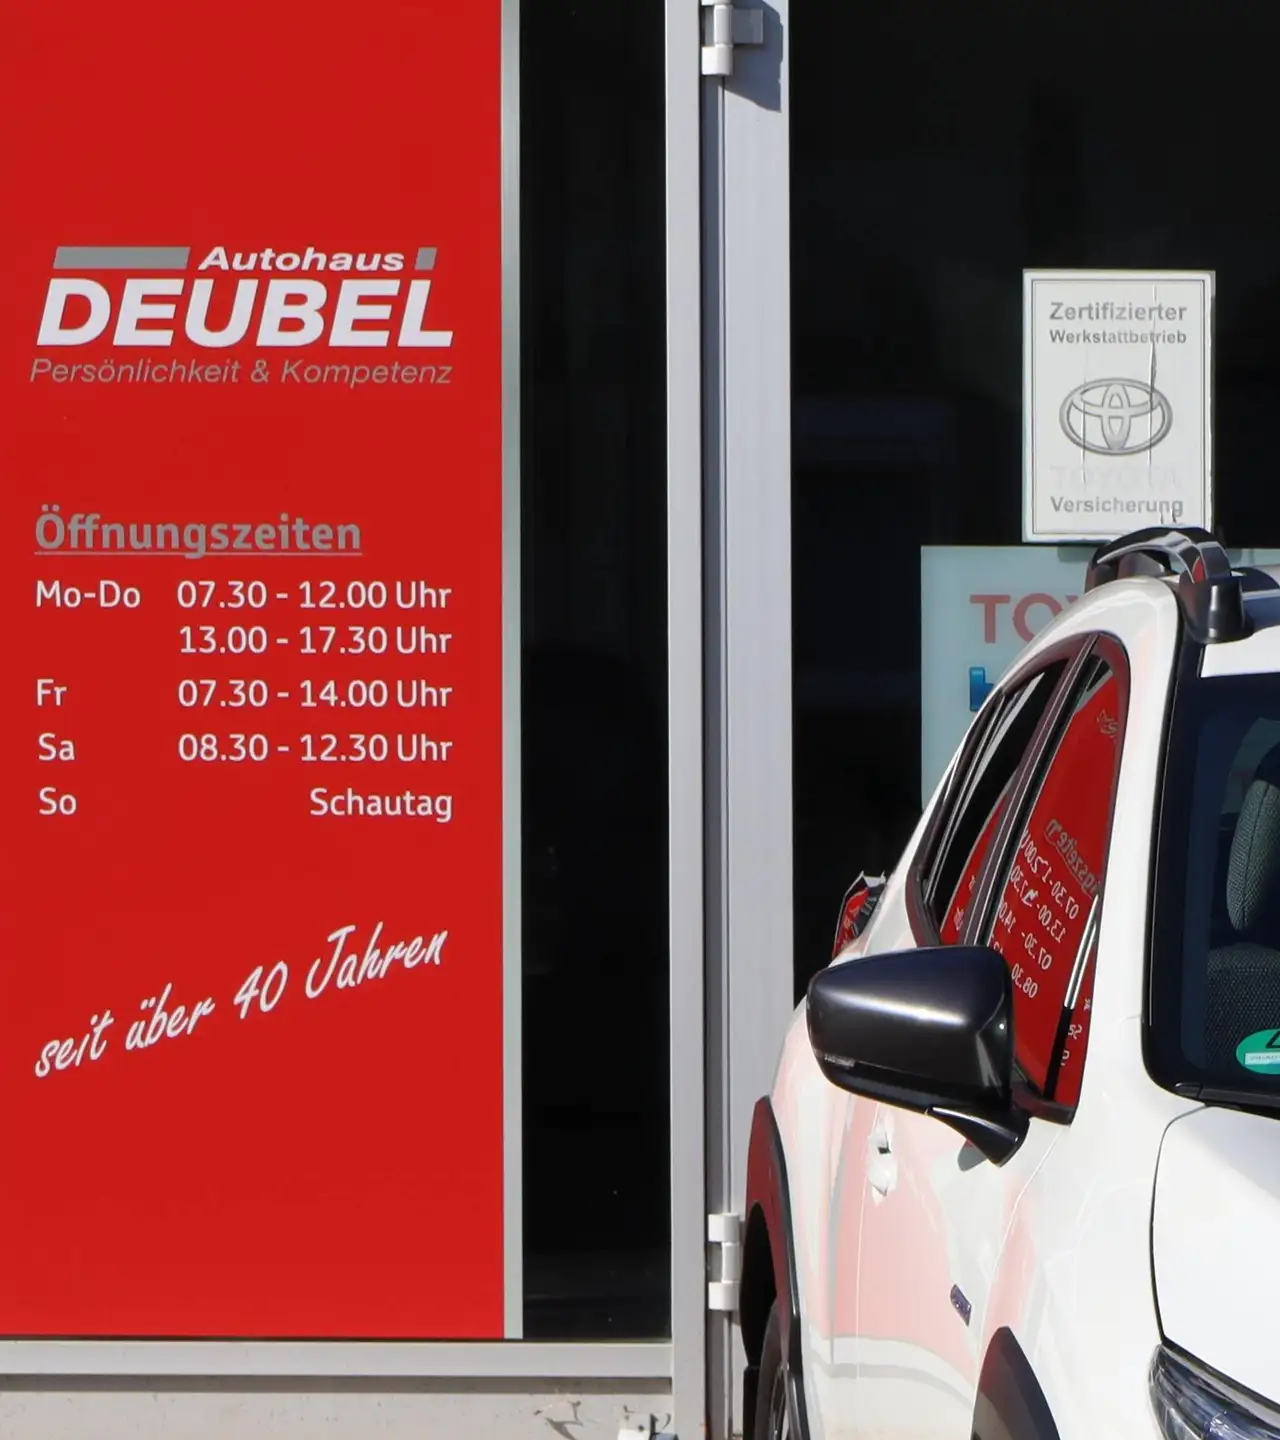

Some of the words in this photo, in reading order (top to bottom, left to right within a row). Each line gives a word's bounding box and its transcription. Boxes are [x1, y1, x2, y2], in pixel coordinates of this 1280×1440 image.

[198, 245, 405, 272] Autohaus
[37, 278, 454, 348] DEUBEL
[1049, 302, 1188, 322] Zertifizierter
[1049, 330, 1187, 344] Werkstattbetrieb
[30, 358, 241, 383] Persönlichkeit
[250, 359, 270, 383] &
[281, 359, 453, 389] Kompetenz
[1050, 496, 1184, 518] Versicherung
[35, 504, 362, 559] Öffnungszeiten
[36, 580, 141, 609] Mo-Do
[177, 580, 268, 609] 07.30
[299, 580, 388, 609] 12.00
[396, 580, 453, 609] Uhr
[969, 593, 1079, 644] TO
[180, 626, 268, 655] 13.00
[300, 626, 388, 655] 17.30
[396, 626, 453, 655] Uhr
[37, 679, 68, 707] Fr
[178, 679, 269, 708] 07.30
[300, 679, 389, 708] 14.00
[396, 679, 454, 708] Uhr
[38, 733, 76, 761] Sa
[178, 733, 269, 762] 08.30
[300, 733, 389, 762] 12.30
[396, 733, 454, 762] Uhr
[39, 787, 77, 816] So
[310, 787, 453, 824] Schautag
[34, 1009, 115, 1079] seit
[125, 982, 216, 1051] über
[233, 961, 289, 1019] 40
[304, 921, 449, 999] Jahren
